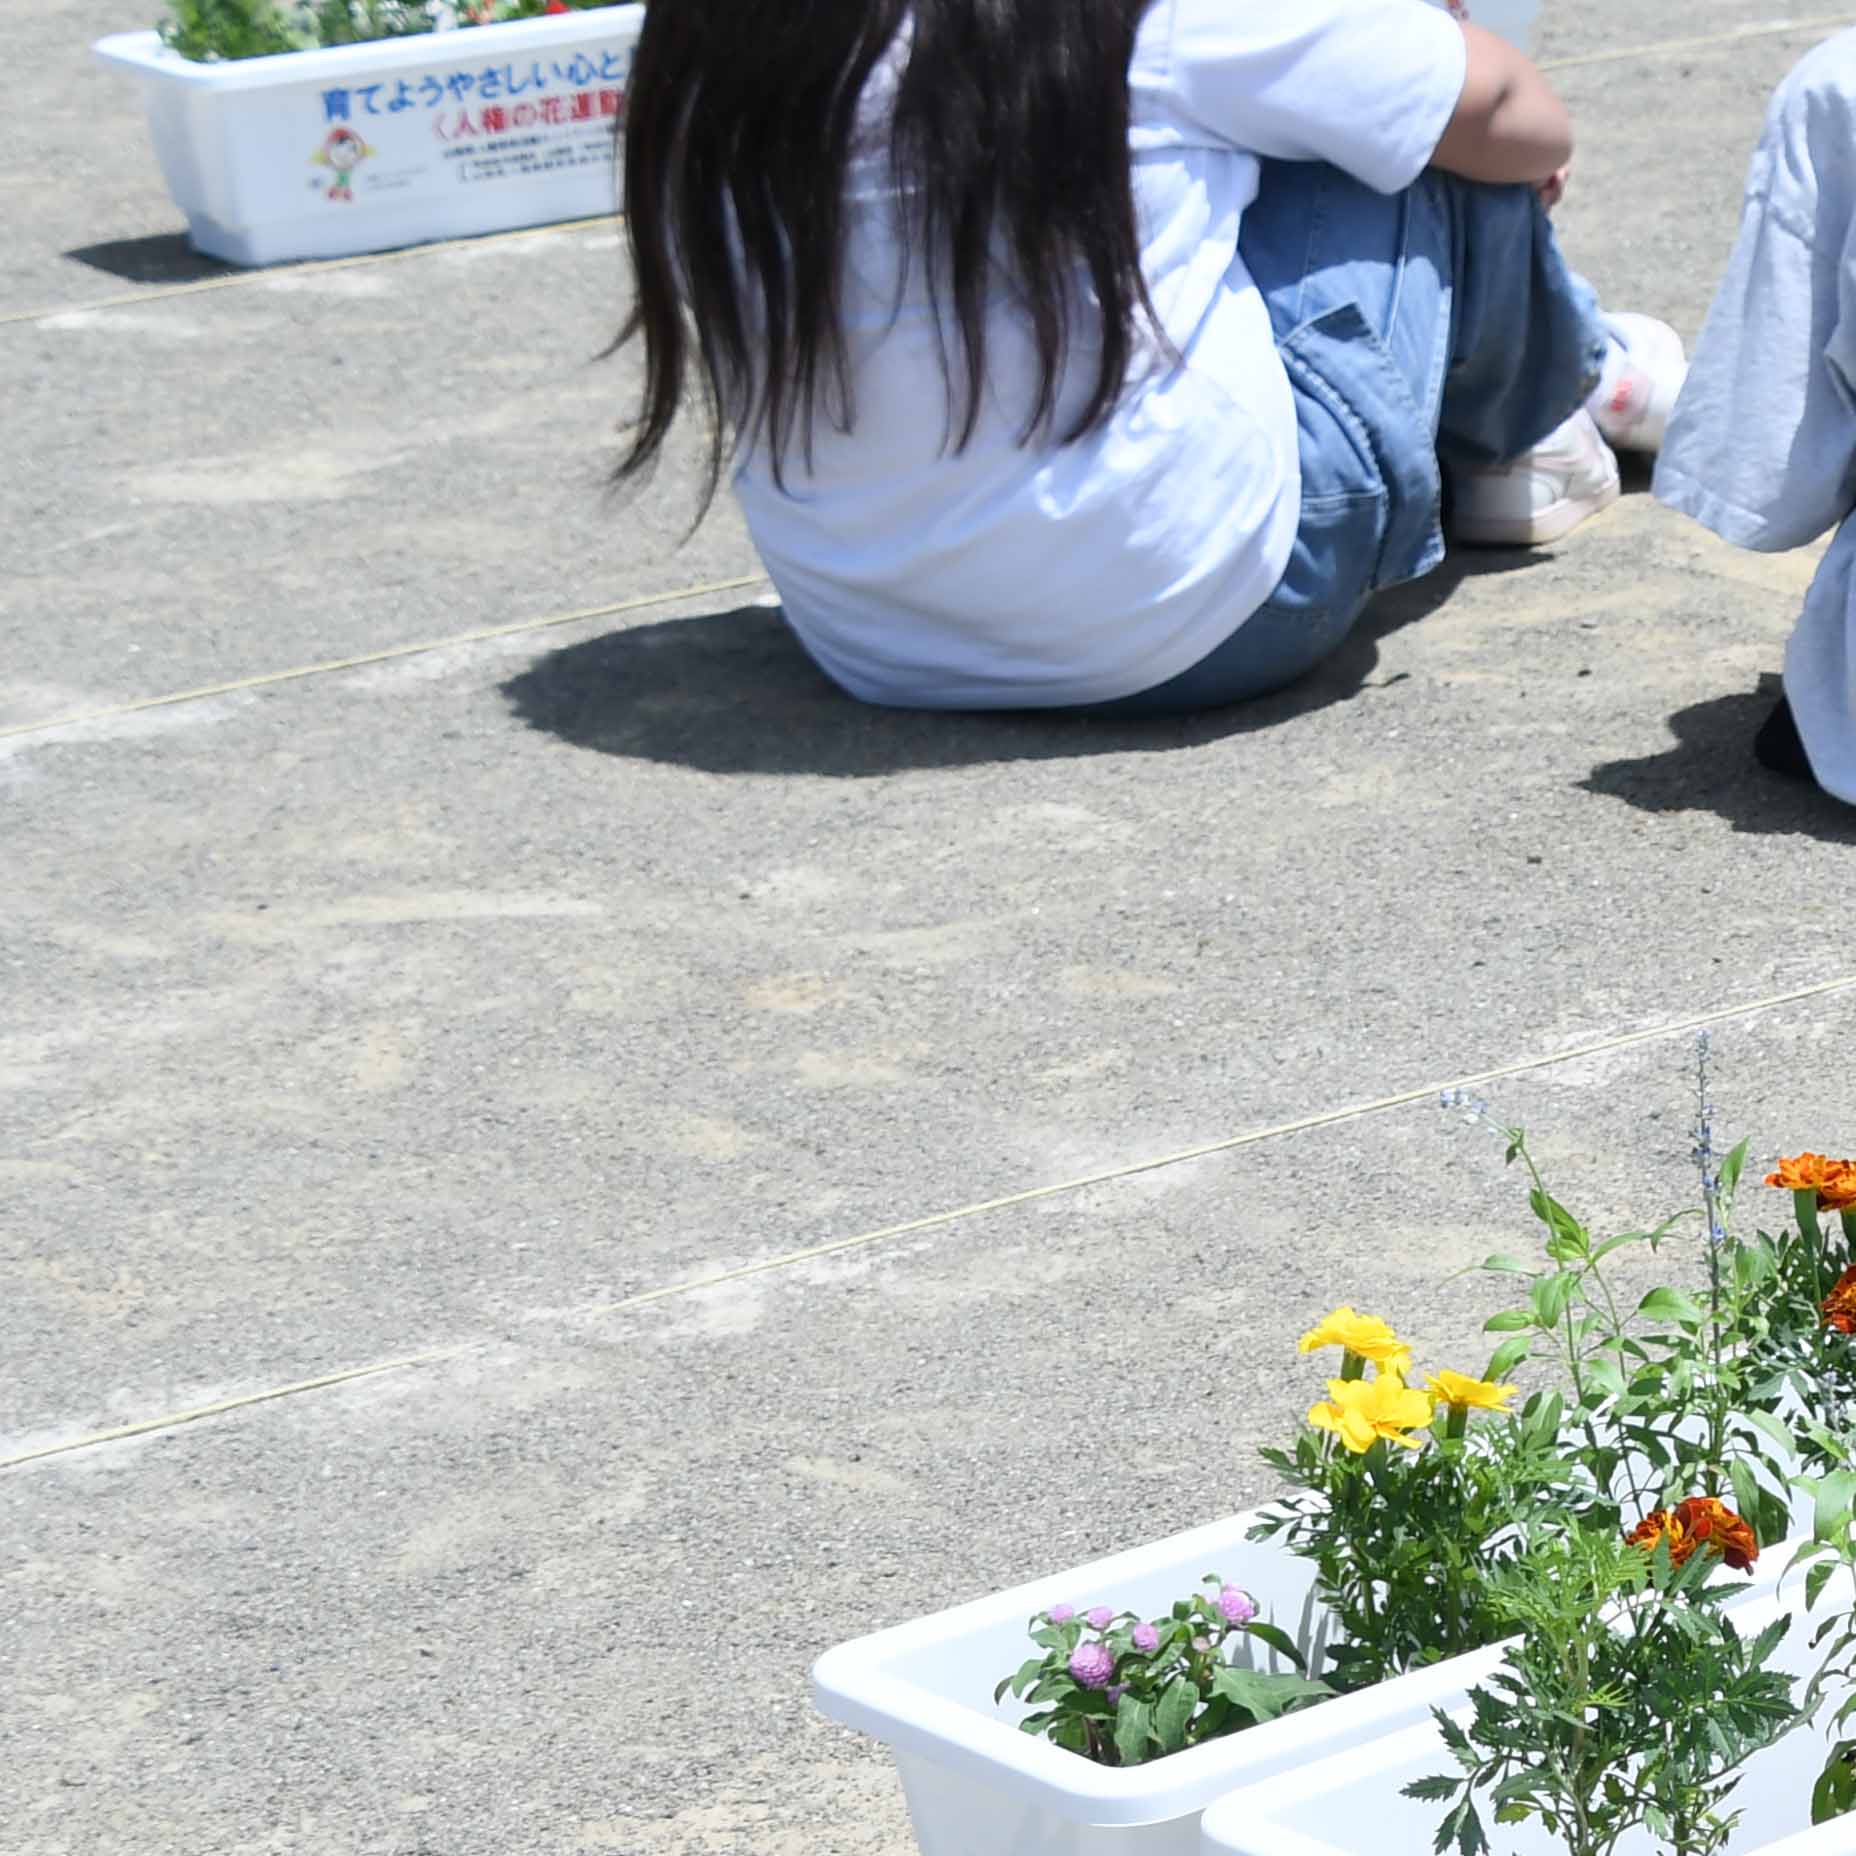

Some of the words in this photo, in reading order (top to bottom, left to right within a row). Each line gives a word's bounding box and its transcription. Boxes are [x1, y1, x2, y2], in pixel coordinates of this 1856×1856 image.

[321, 48, 636, 122] 育てようやさしい心と
